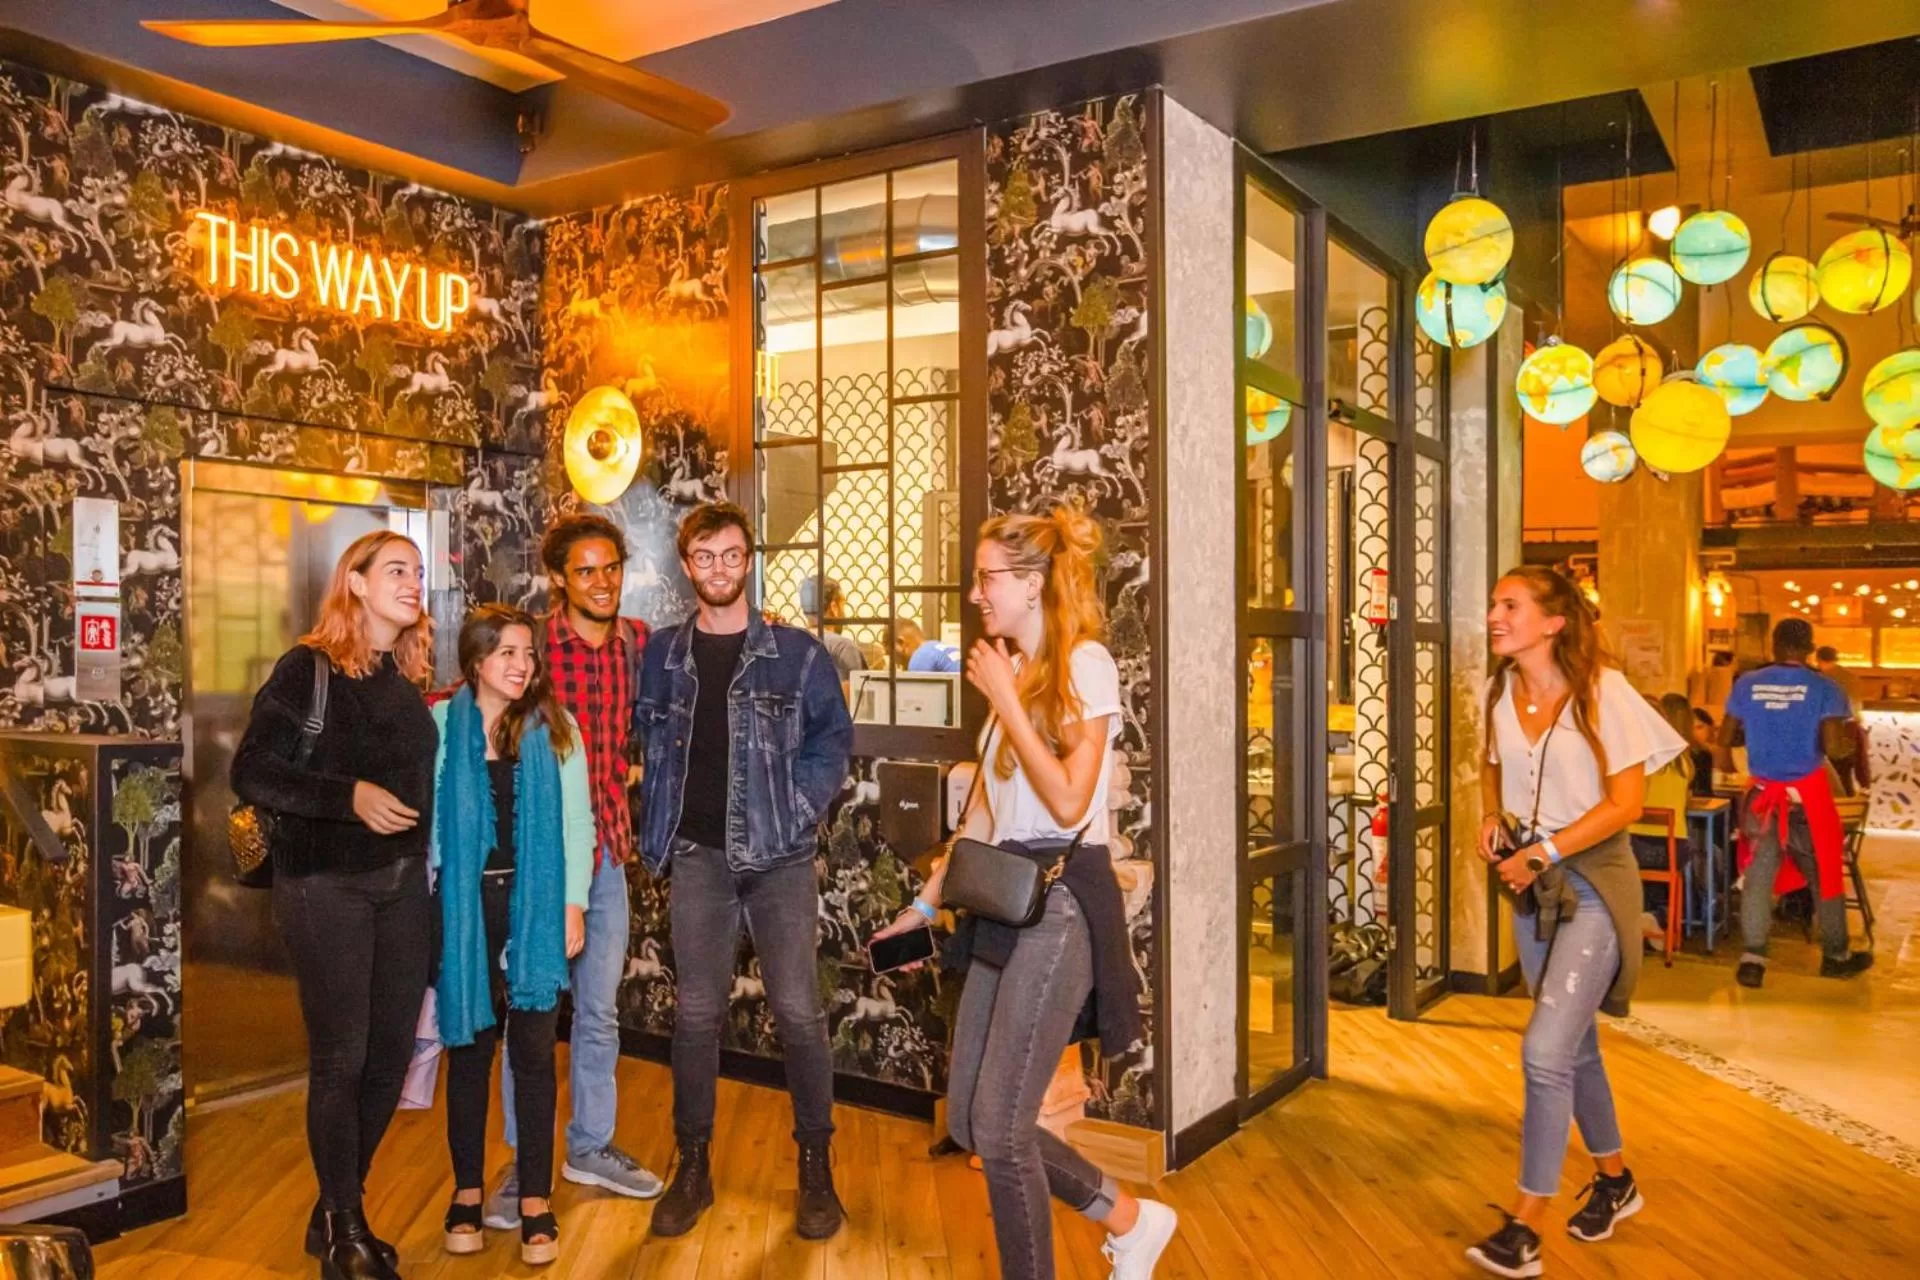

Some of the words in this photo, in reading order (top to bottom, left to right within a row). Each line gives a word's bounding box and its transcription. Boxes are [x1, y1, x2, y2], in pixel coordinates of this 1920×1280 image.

[195, 211, 300, 300] THIS
[309, 240, 411, 323] WAY
[419, 267, 470, 333] UP
